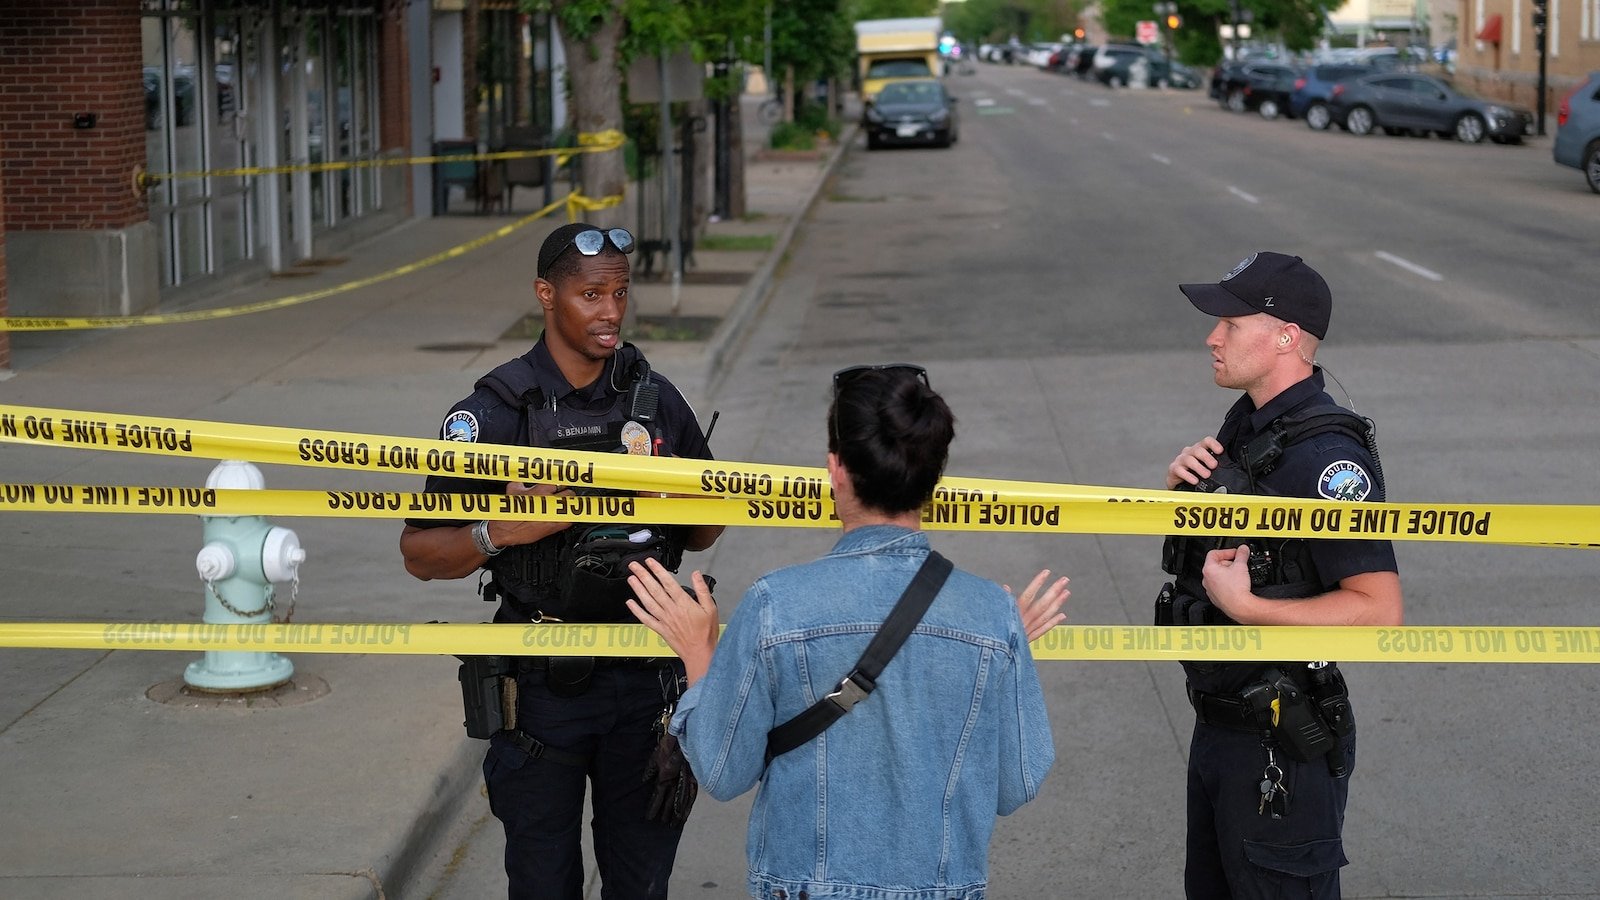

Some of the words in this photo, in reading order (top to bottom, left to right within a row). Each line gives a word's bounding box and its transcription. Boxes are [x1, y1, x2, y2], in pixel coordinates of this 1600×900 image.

[1264, 296, 1275, 307] Z
[24, 415, 54, 441] DO
[61, 418, 109, 445] LINE
[115, 424, 193, 452] POLICE
[557, 429, 566, 437] S.
[565, 426, 602, 436] BENJAMIN
[298, 437, 370, 466] CROSS
[377, 444, 419, 470] NOT
[426, 448, 455, 473] DO
[464, 452, 510, 477] LINE
[518, 456, 595, 484] POLICE
[1323, 463, 1364, 483] BOULDER
[0, 484, 35, 504] NO
[43, 485, 73, 504] DO
[701, 469, 772, 497] CROSS
[779, 475, 822, 500] NOT
[82, 486, 130, 506] LINE
[138, 486, 216, 507] POLICE
[327, 491, 401, 510] CROSS
[409, 493, 452, 512] NOT
[461, 493, 490, 513] DO
[500, 495, 547, 515] LINE
[557, 496, 635, 516] POLICE
[1335, 490, 1365, 502] POICE
[748, 500, 822, 520] CROSS
[922, 502, 970, 524] LINE
[979, 504, 1060, 527] POLICE
[1174, 506, 1250, 530] CROSS
[1256, 507, 1303, 531] NOT
[1310, 508, 1342, 532] DO
[1349, 509, 1401, 533] LINE
[1407, 510, 1491, 535] POLICE
